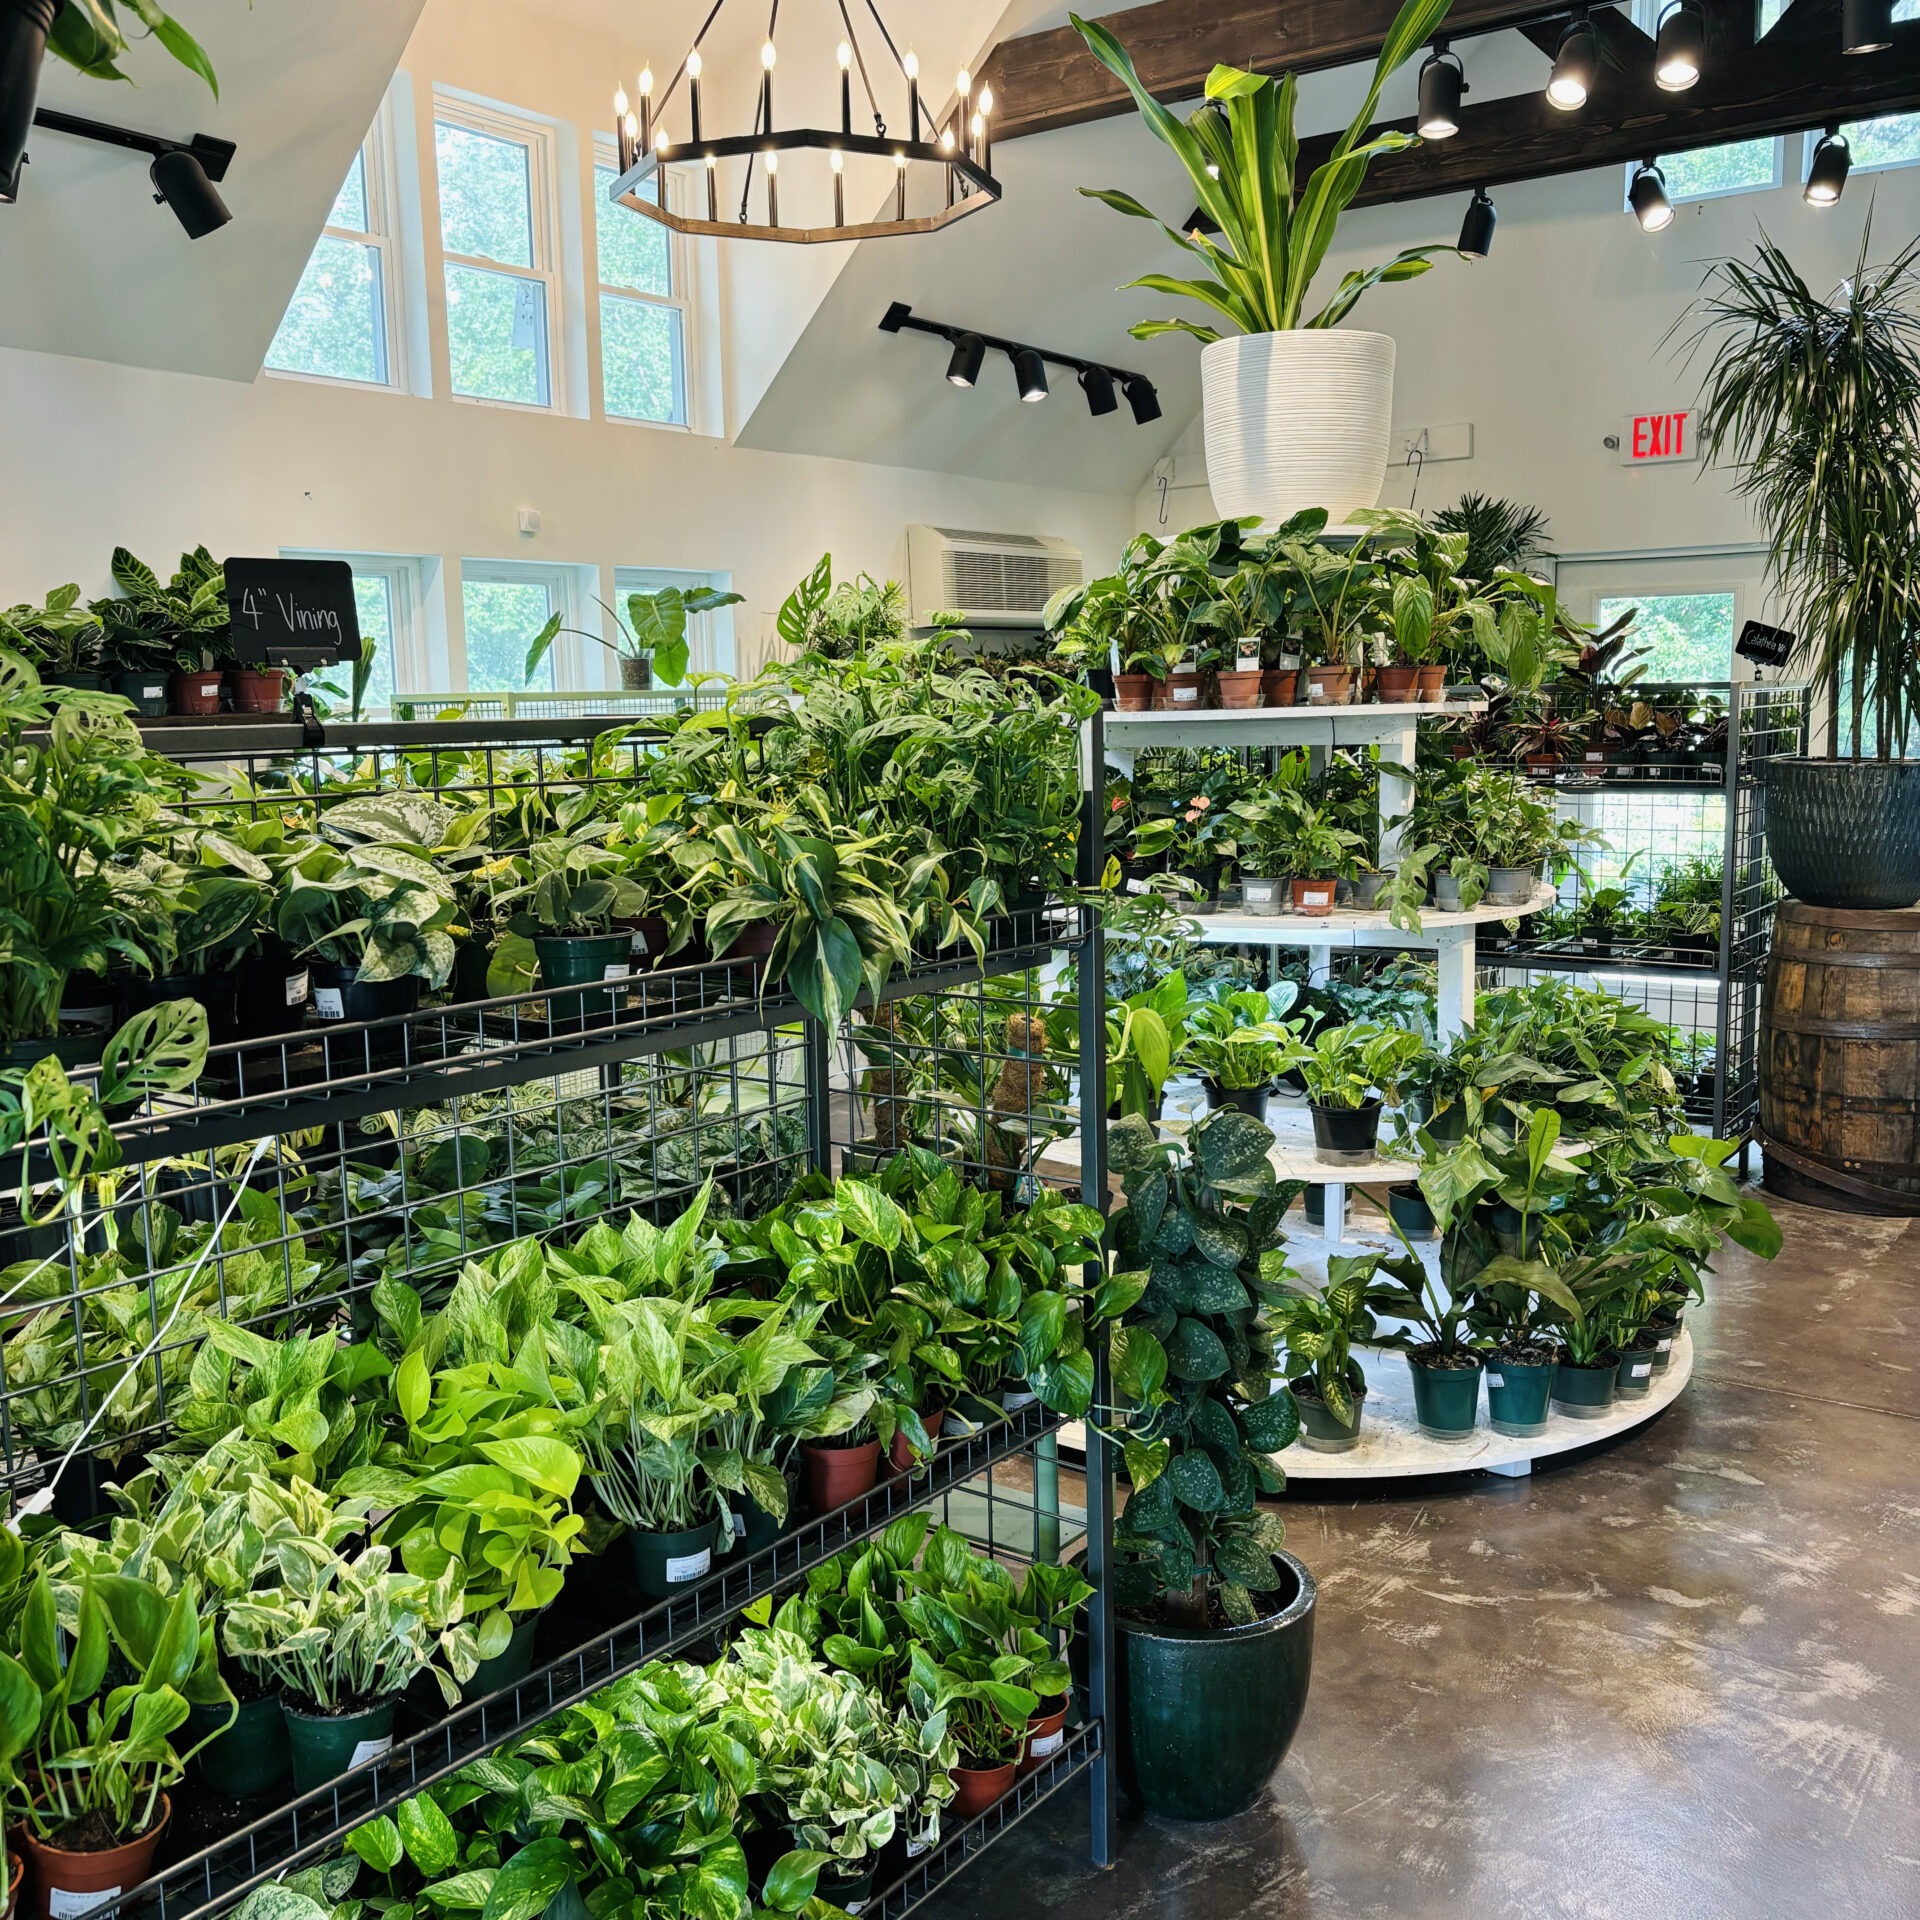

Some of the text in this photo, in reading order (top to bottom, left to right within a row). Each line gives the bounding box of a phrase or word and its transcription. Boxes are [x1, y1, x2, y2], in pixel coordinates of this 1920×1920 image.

[1632, 412, 1688, 459] EXIT
[242, 587, 342, 645] 4" Vining
[1744, 629, 1777, 650] Calathea
